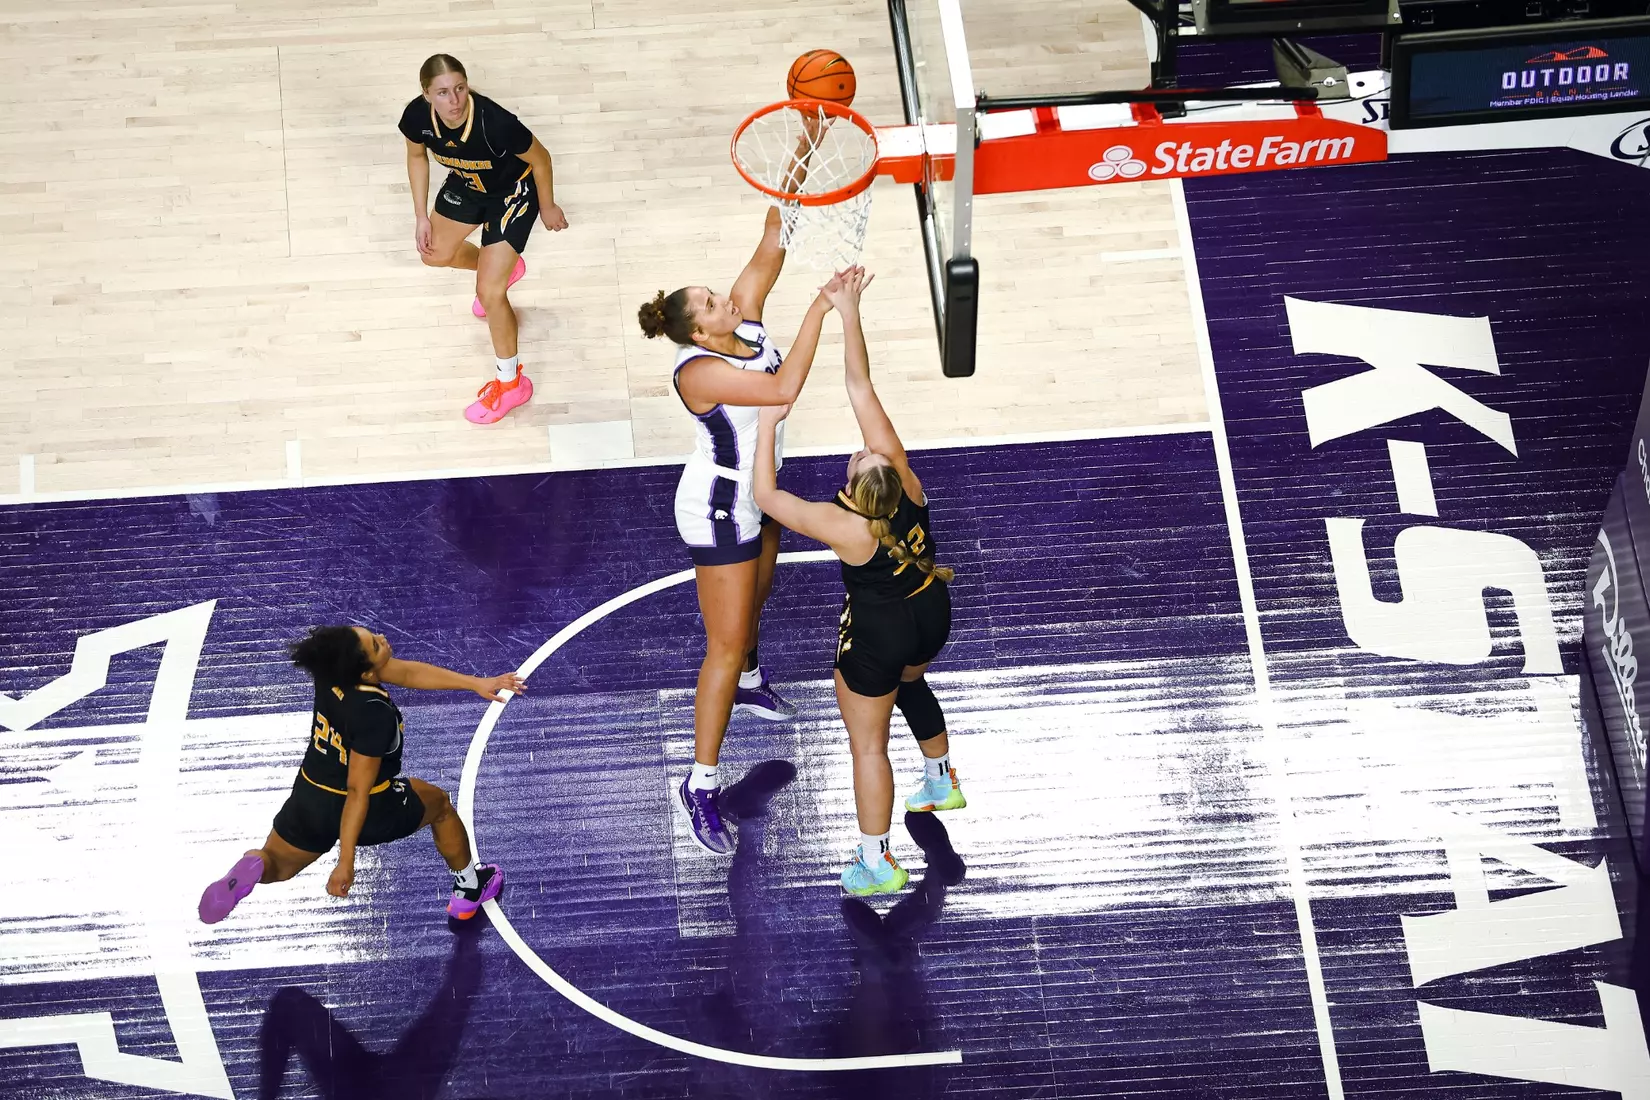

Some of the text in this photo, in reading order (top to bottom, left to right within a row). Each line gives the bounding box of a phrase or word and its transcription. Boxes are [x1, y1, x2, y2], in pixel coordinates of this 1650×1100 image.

[1501, 63, 1629, 90] OUTDOOR
[1489, 98, 1522, 107] Member
[1524, 97, 1544, 105] FDIC
[1551, 94, 1574, 103] Equal
[1575, 90, 1608, 100] Housing
[1610, 88, 1639, 98] Lender
[1592, 528, 1648, 770] Dillons
[313, 711, 348, 766] 24
